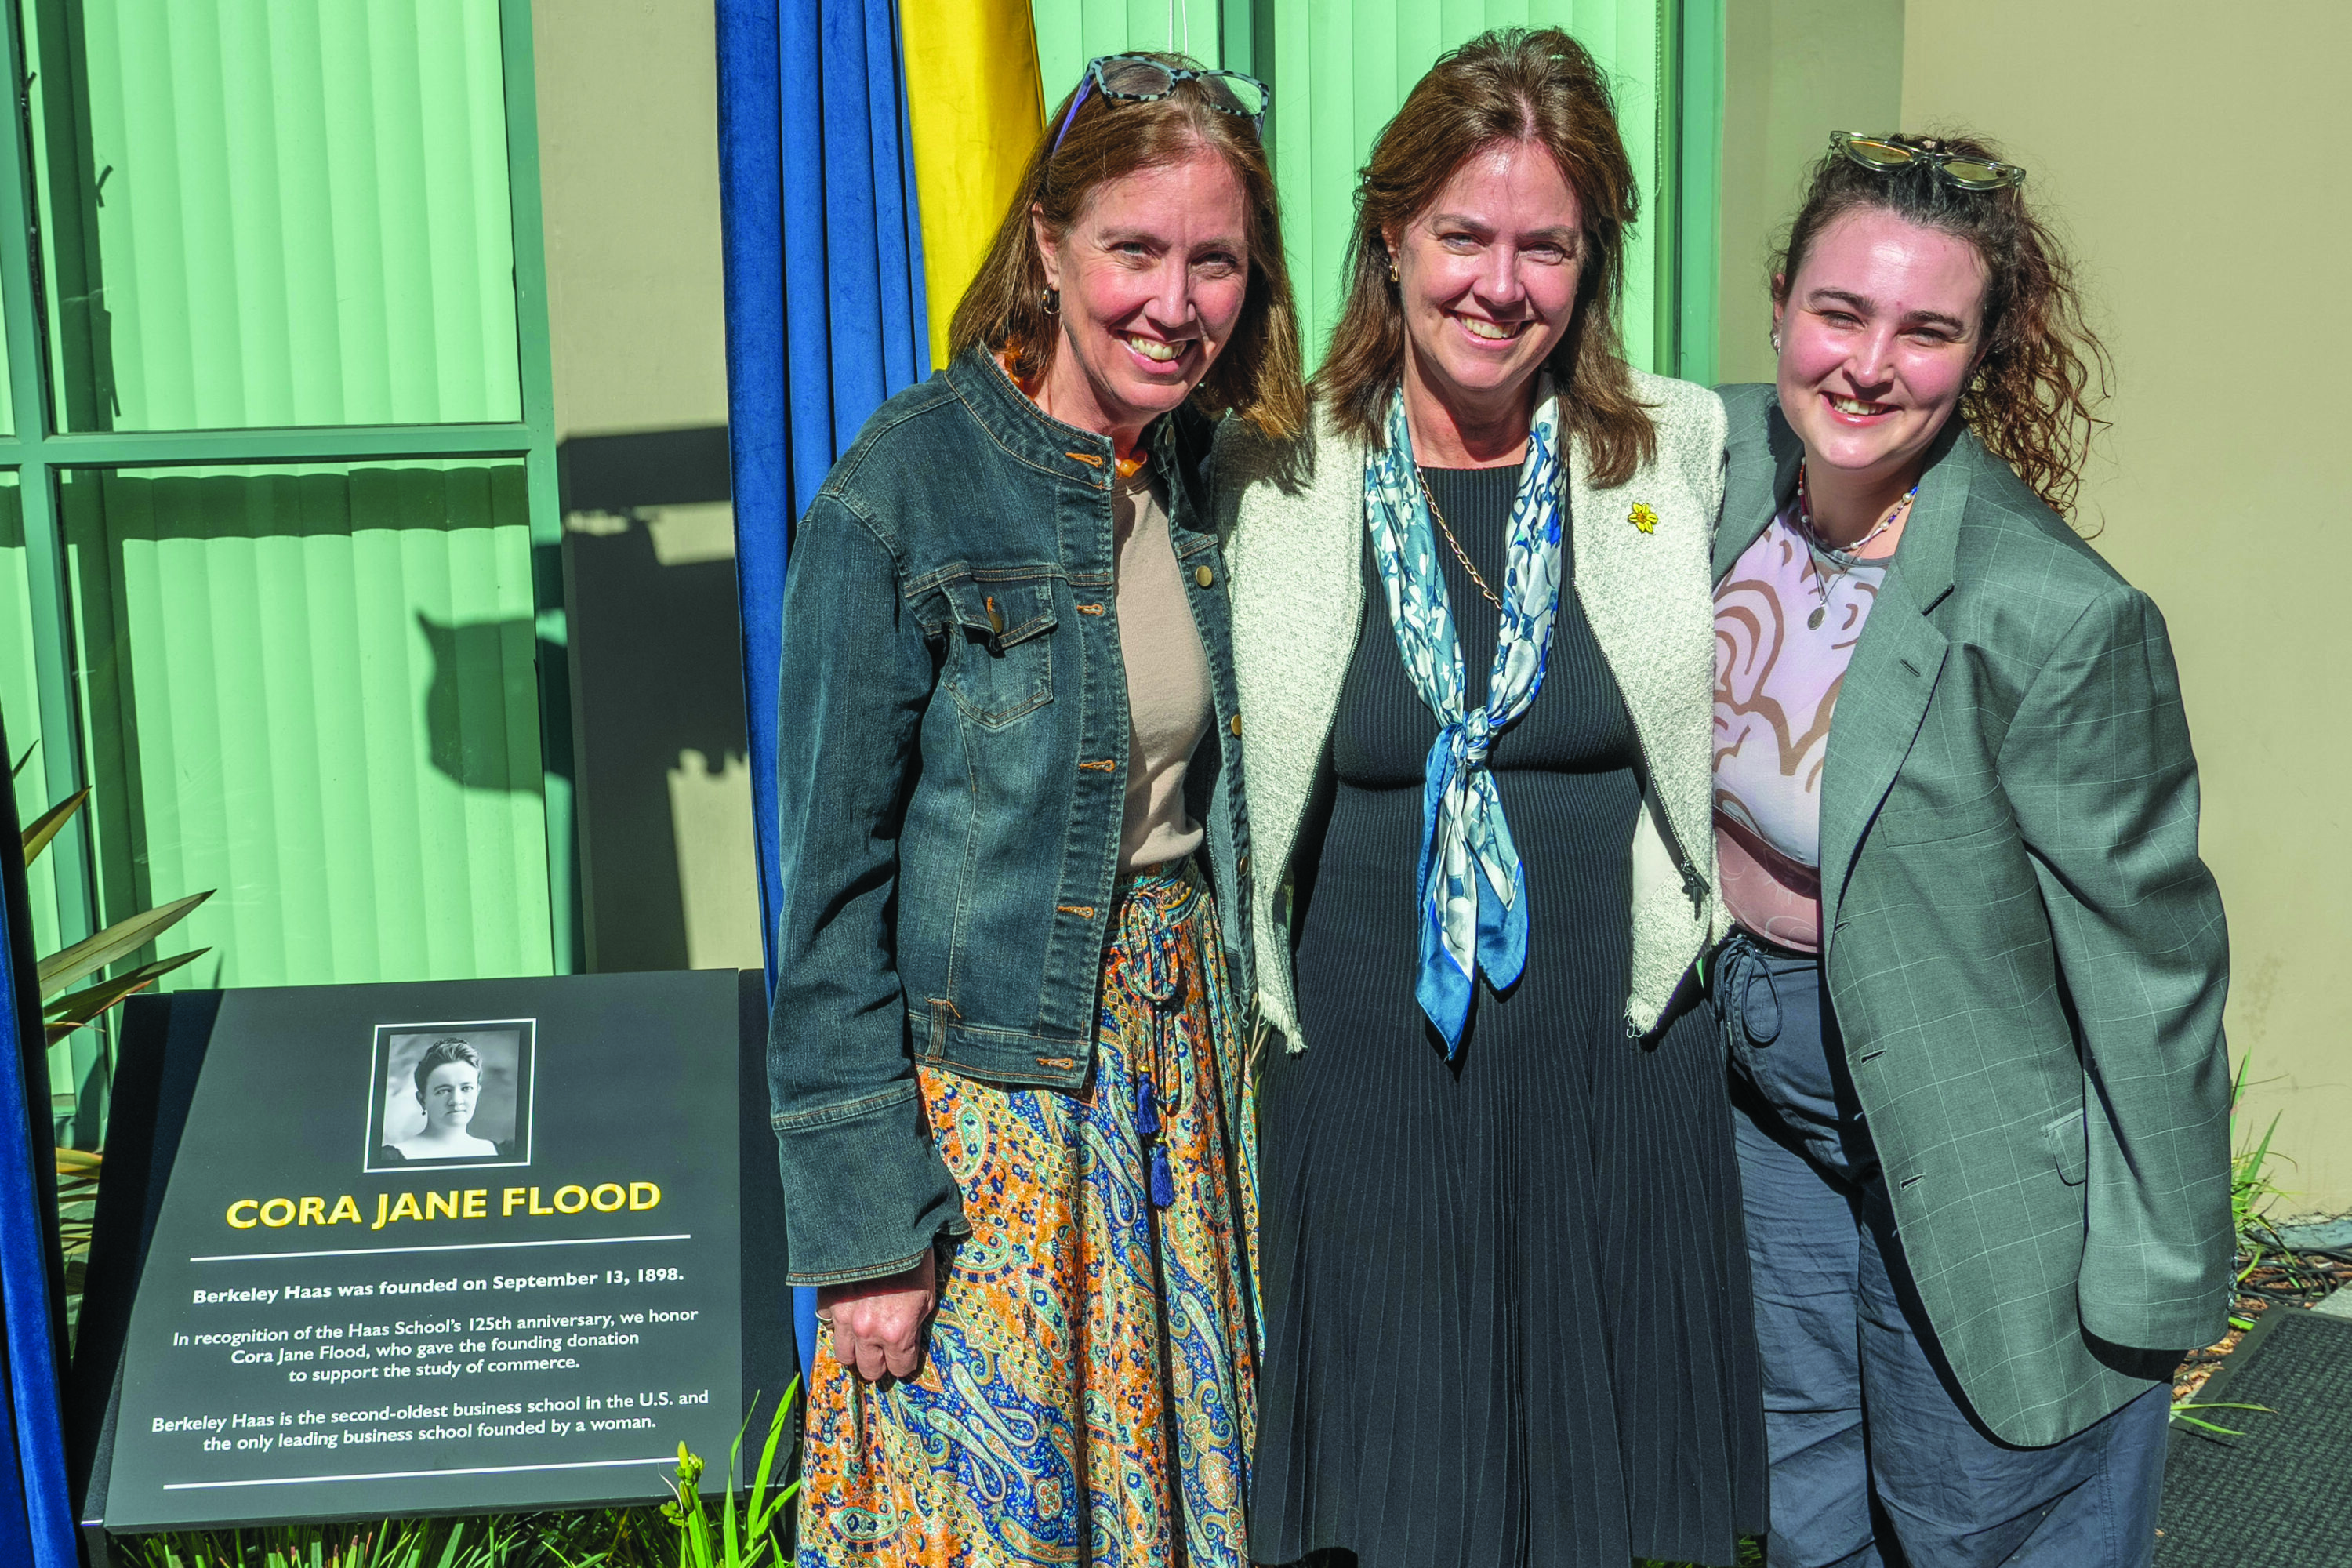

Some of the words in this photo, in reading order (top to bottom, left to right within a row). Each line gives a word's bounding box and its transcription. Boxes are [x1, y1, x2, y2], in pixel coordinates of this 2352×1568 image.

[226, 1195, 362, 1229] CORA
[371, 1189, 488, 1230] JANE
[502, 1181, 661, 1217] FLOOD
[192, 1287, 279, 1305] Berkeley
[284, 1285, 332, 1300] Haas
[337, 1284, 374, 1297] was
[379, 1277, 458, 1295] founded
[463, 1279, 488, 1291] on
[492, 1272, 599, 1293] September
[606, 1269, 630, 1286] 13,
[638, 1267, 684, 1283] 1898.
[172, 1331, 189, 1346] In
[194, 1328, 289, 1347] recognition
[293, 1325, 313, 1340] of
[314, 1324, 343, 1339] the
[348, 1323, 390, 1338] Haas
[394, 1318, 462, 1335] School’s
[469, 1316, 512, 1332] 125th
[517, 1314, 615, 1330] anniversary,
[619, 1313, 644, 1324] we
[648, 1308, 699, 1323] honor
[230, 1349, 274, 1364] Cora
[276, 1347, 314, 1366] Jane
[319, 1343, 371, 1360] Flood,
[376, 1341, 412, 1357] who
[416, 1343, 454, 1359] gave
[459, 1338, 487, 1353] the
[491, 1334, 563, 1352] founding
[566, 1331, 639, 1348] donation
[289, 1370, 307, 1383] to
[312, 1366, 379, 1385] support
[383, 1363, 412, 1377] the
[416, 1360, 462, 1378] study
[466, 1358, 485, 1374] of
[487, 1358, 580, 1373] commerce.
[151, 1414, 227, 1433] Berkeley
[231, 1413, 274, 1428] Haas
[279, 1411, 293, 1426] is
[297, 1410, 326, 1425] the
[330, 1403, 448, 1424] second-oldest
[452, 1401, 522, 1417] business
[527, 1396, 581, 1414] school
[586, 1396, 601, 1410] in
[606, 1394, 634, 1409] the
[639, 1391, 674, 1407] U.S.
[678, 1389, 709, 1405] and
[202, 1436, 232, 1452] the
[236, 1433, 274, 1453] only
[278, 1431, 339, 1449] leading
[343, 1428, 413, 1444] business
[418, 1423, 473, 1440] school
[477, 1419, 546, 1437] founded
[551, 1418, 572, 1437] by
[575, 1421, 586, 1432] a
[590, 1417, 656, 1431] woman.
